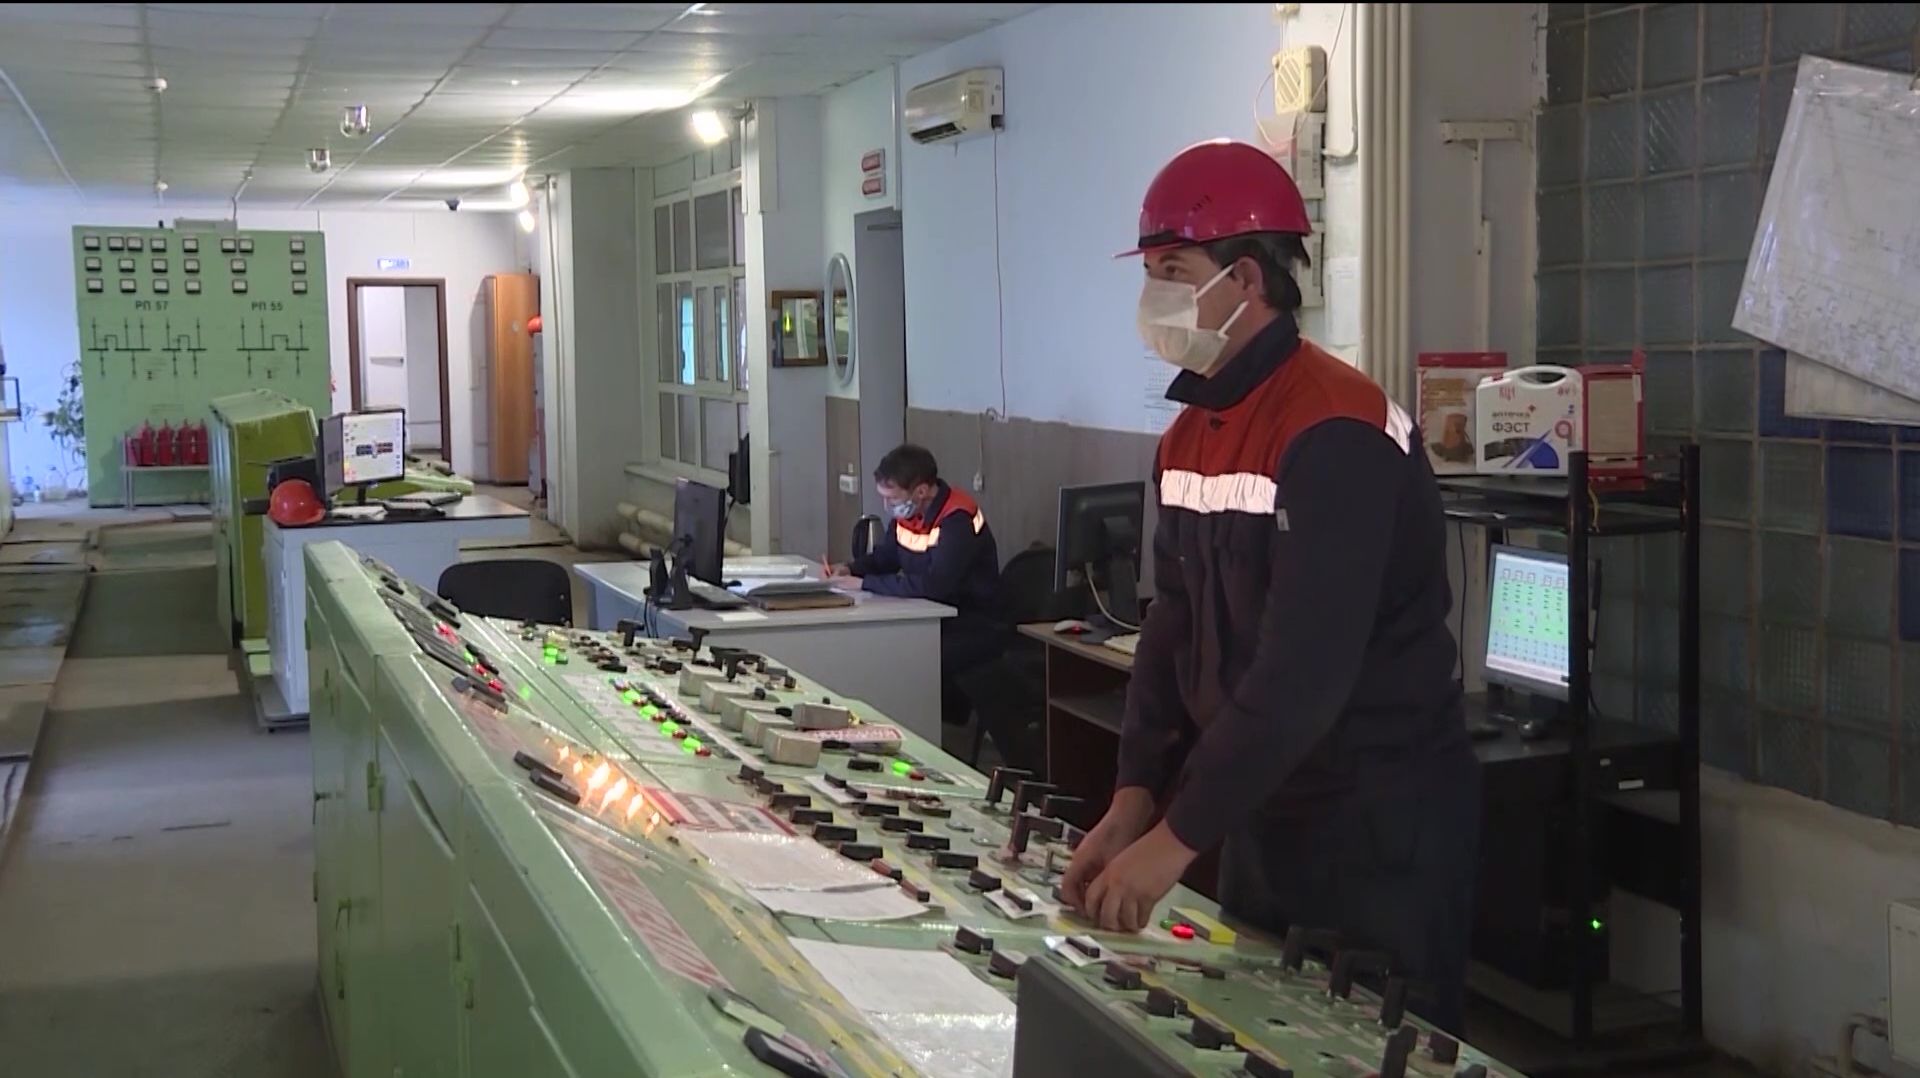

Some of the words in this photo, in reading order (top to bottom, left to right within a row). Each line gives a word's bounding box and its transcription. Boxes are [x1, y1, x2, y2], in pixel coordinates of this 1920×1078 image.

[135, 300, 151, 311] РП
[156, 300, 169, 311] 57
[251, 301, 267, 312] РП
[1492, 422, 1530, 433] ФЭСТ
